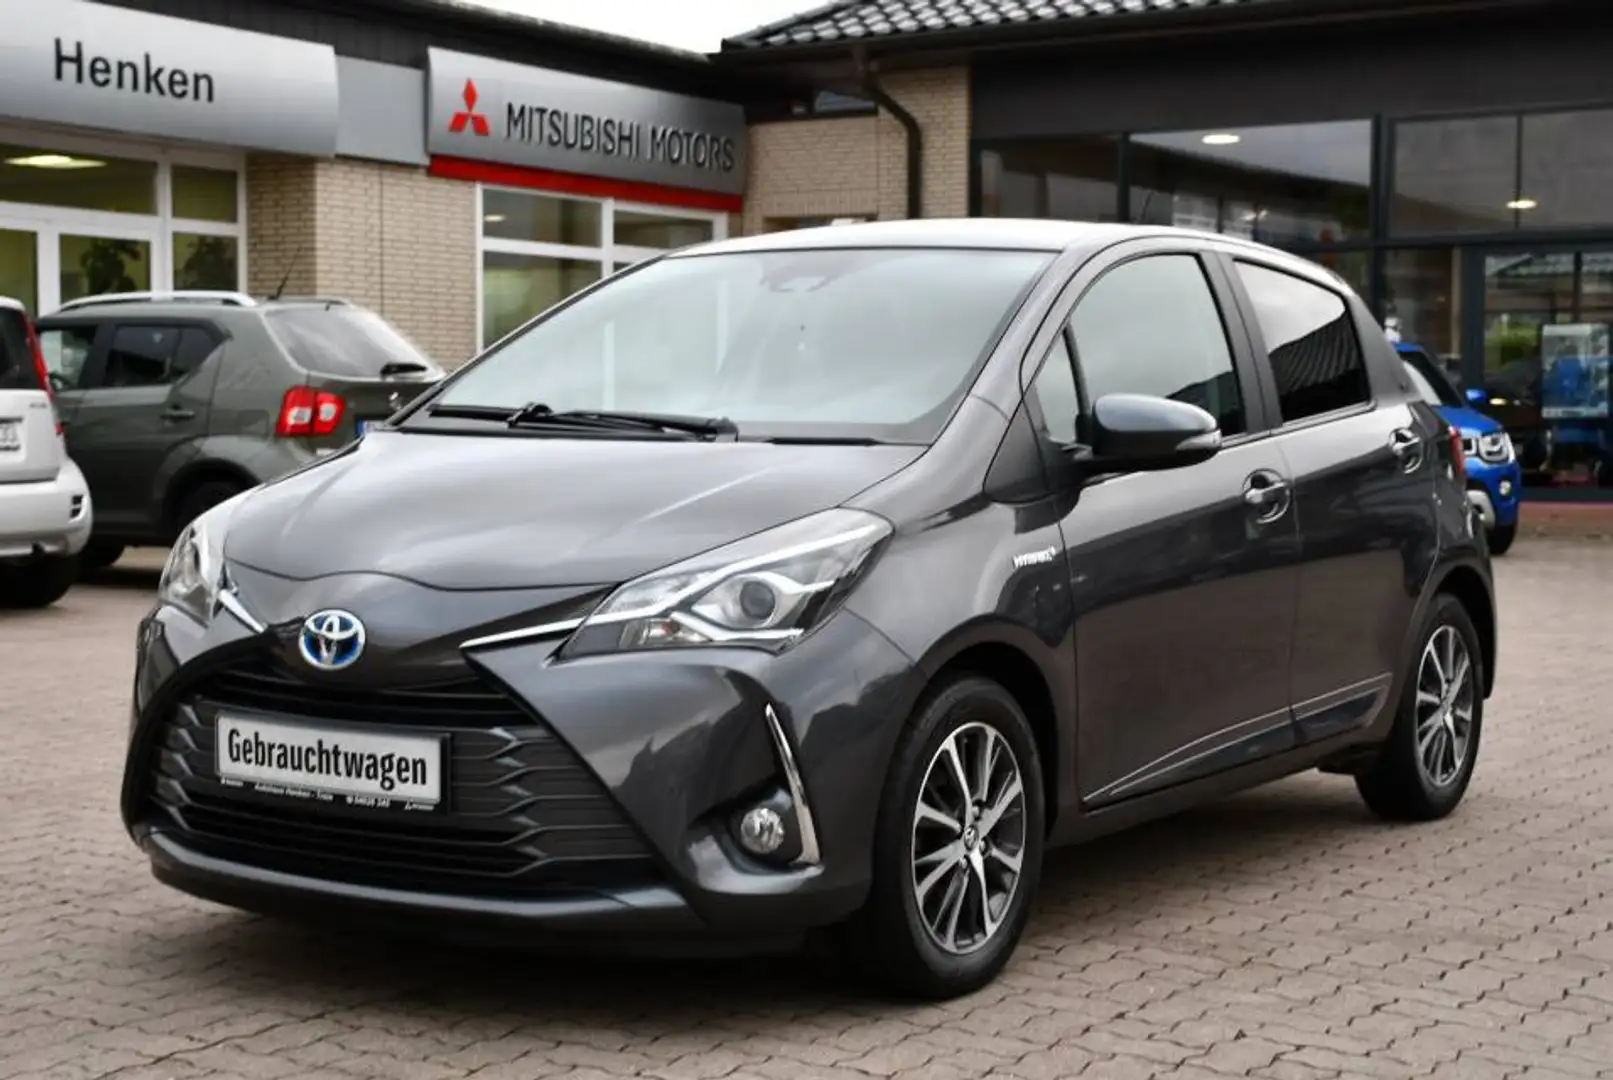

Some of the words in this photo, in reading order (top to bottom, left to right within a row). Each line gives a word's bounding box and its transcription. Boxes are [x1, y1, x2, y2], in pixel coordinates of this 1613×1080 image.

[54, 36, 214, 103] Henken
[506, 102, 641, 162] MITSUBISHI
[649, 124, 736, 173] MOTORS
[228, 728, 427, 791] Gebrauchtwagen
